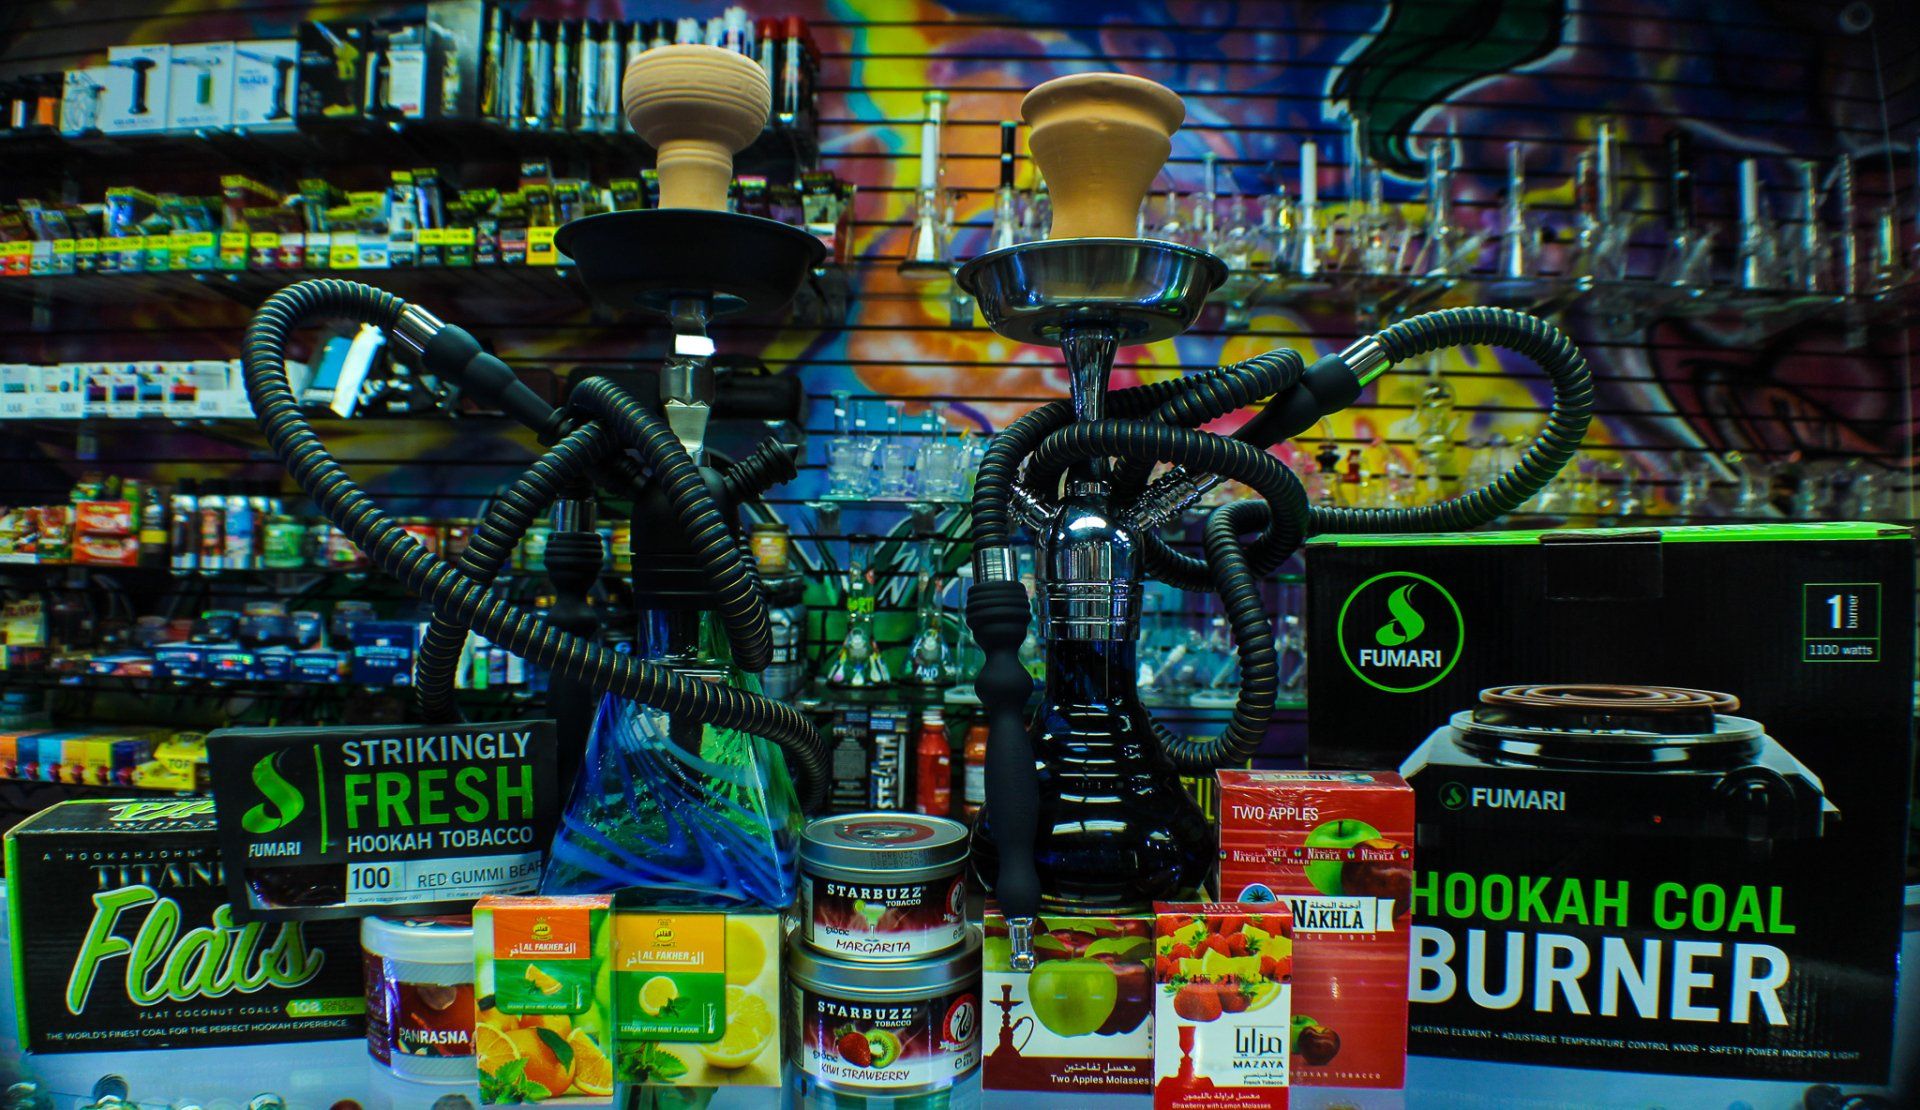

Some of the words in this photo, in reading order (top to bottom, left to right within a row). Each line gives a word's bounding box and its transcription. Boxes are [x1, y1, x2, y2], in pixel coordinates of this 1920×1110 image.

[1825, 593, 1843, 630] 1
[1845, 594, 1859, 629] burner
[1359, 647, 1442, 669] FUMARI
[1808, 644, 1840, 656] 1100
[1842, 646, 1874, 656] watts
[341, 731, 532, 768] STRIKINGLY
[344, 764, 534, 829] FRESH
[1471, 786, 1567, 812] FUMARI
[1232, 805, 1265, 820] TWO
[1267, 807, 1320, 821] APPLES
[248, 841, 302, 858] FUMARI
[347, 831, 433, 854] HOOKAH
[438, 826, 534, 849] TOBACCO
[43, 852, 51, 861] A
[90, 861, 228, 889] TITANI
[351, 866, 392, 891] 100
[418, 873, 447, 888] RED
[450, 867, 505, 885] GUMMI
[826, 883, 924, 900] STARBUZZ
[885, 900, 922, 908] TOBACCO
[1410, 870, 1630, 928] HOOKAH
[1652, 881, 1797, 935] COAL
[1291, 899, 1365, 929] NAKHLA
[523, 942, 533, 951] AL
[535, 942, 564, 952] FAKHER
[642, 951, 654, 961] AL
[655, 951, 690, 961] FAKHER
[835, 938, 911, 954] MARGARITA
[1408, 924, 1791, 1027] BURNER
[139, 1010, 169, 1020] FLAT
[175, 1007, 233, 1018] COCONUT
[239, 1004, 280, 1015] COALS
[817, 1000, 913, 1020] STARBUZZ
[46, 1031, 63, 1041] THE
[65, 1029, 107, 1040] WORLD'S
[108, 1027, 140, 1039] FINEST
[141, 1026, 167, 1037] COAL
[168, 1025, 188, 1036] FOR
[190, 1024, 208, 1034] THE
[209, 1023, 249, 1034] PERFECT
[250, 1020, 291, 1032] HOOKAH
[292, 1018, 348, 1030] EXPERIENCE
[1235, 1027, 1283, 1058] مزايا
[1410, 1024, 1449, 1036] HEATING
[1451, 1027, 1493, 1039] ELEMENT
[1502, 1031, 1558, 1044] ADJUSTABLE
[1559, 1035, 1625, 1049] TEMPERATURE
[1627, 1040, 1670, 1052] CONTROL
[1672, 1042, 1700, 1053] KNOB
[1708, 1044, 1744, 1056] SAFETY
[1745, 1047, 1779, 1057] POWER
[1781, 1048, 1831, 1060] INDICATOR
[820, 1063, 840, 1076] KIWI
[841, 1067, 911, 1082] STRAWBERRY
[1232, 1060, 1284, 1069] MAZAYA
[1050, 1074, 1070, 1084] Two
[1072, 1074, 1104, 1087] Apples
[1105, 1074, 1150, 1086] Molasses
[1171, 1101, 1206, 1110] Strawberry
[1206, 1102, 1220, 1110] with
[1219, 1102, 1241, 1110] Lemon
[1242, 1102, 1272, 1110] Molasses
